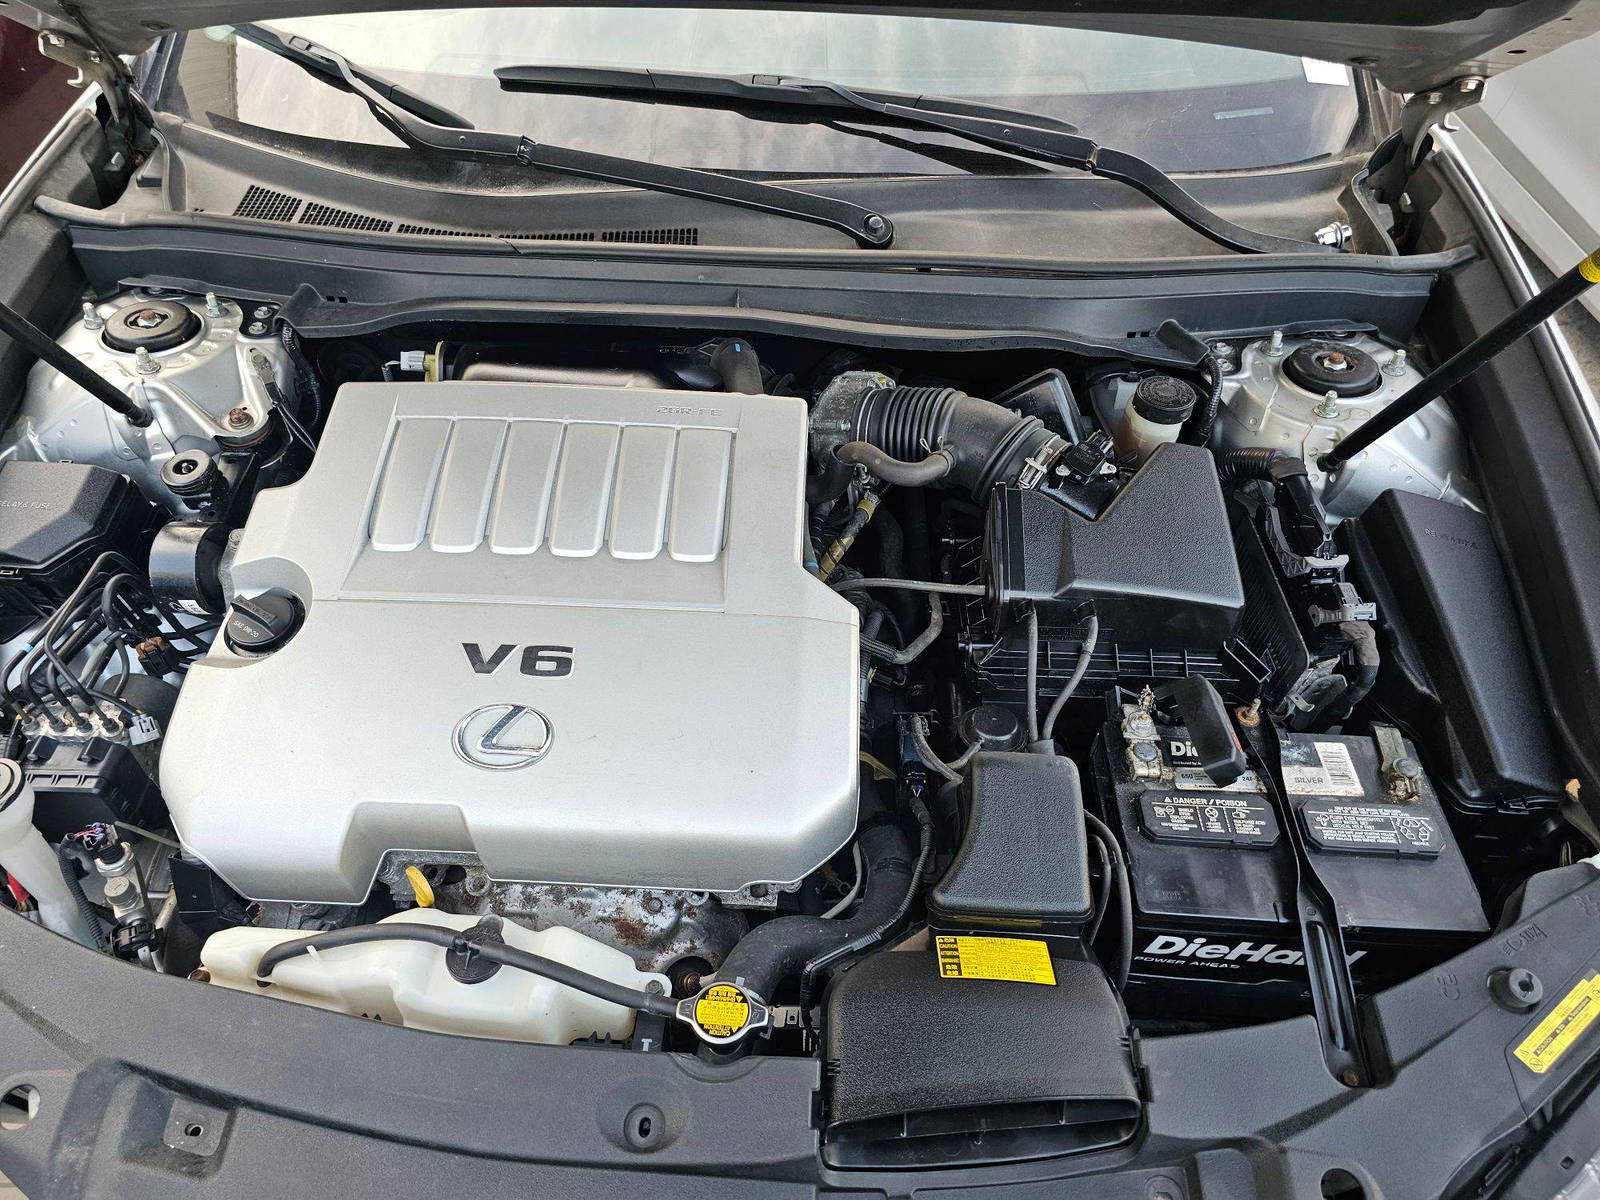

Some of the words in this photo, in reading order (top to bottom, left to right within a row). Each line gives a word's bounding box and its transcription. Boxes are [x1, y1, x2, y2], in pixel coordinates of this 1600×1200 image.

[461, 642, 575, 678] V6
[1295, 776, 1324, 785] SILVER
[1172, 797, 1208, 806] DANGER
[1215, 799, 1248, 807] POISON
[1143, 935, 1367, 967] DieHay
[1134, 956, 1186, 965] POWER
[1189, 961, 1240, 969] AHEAD
